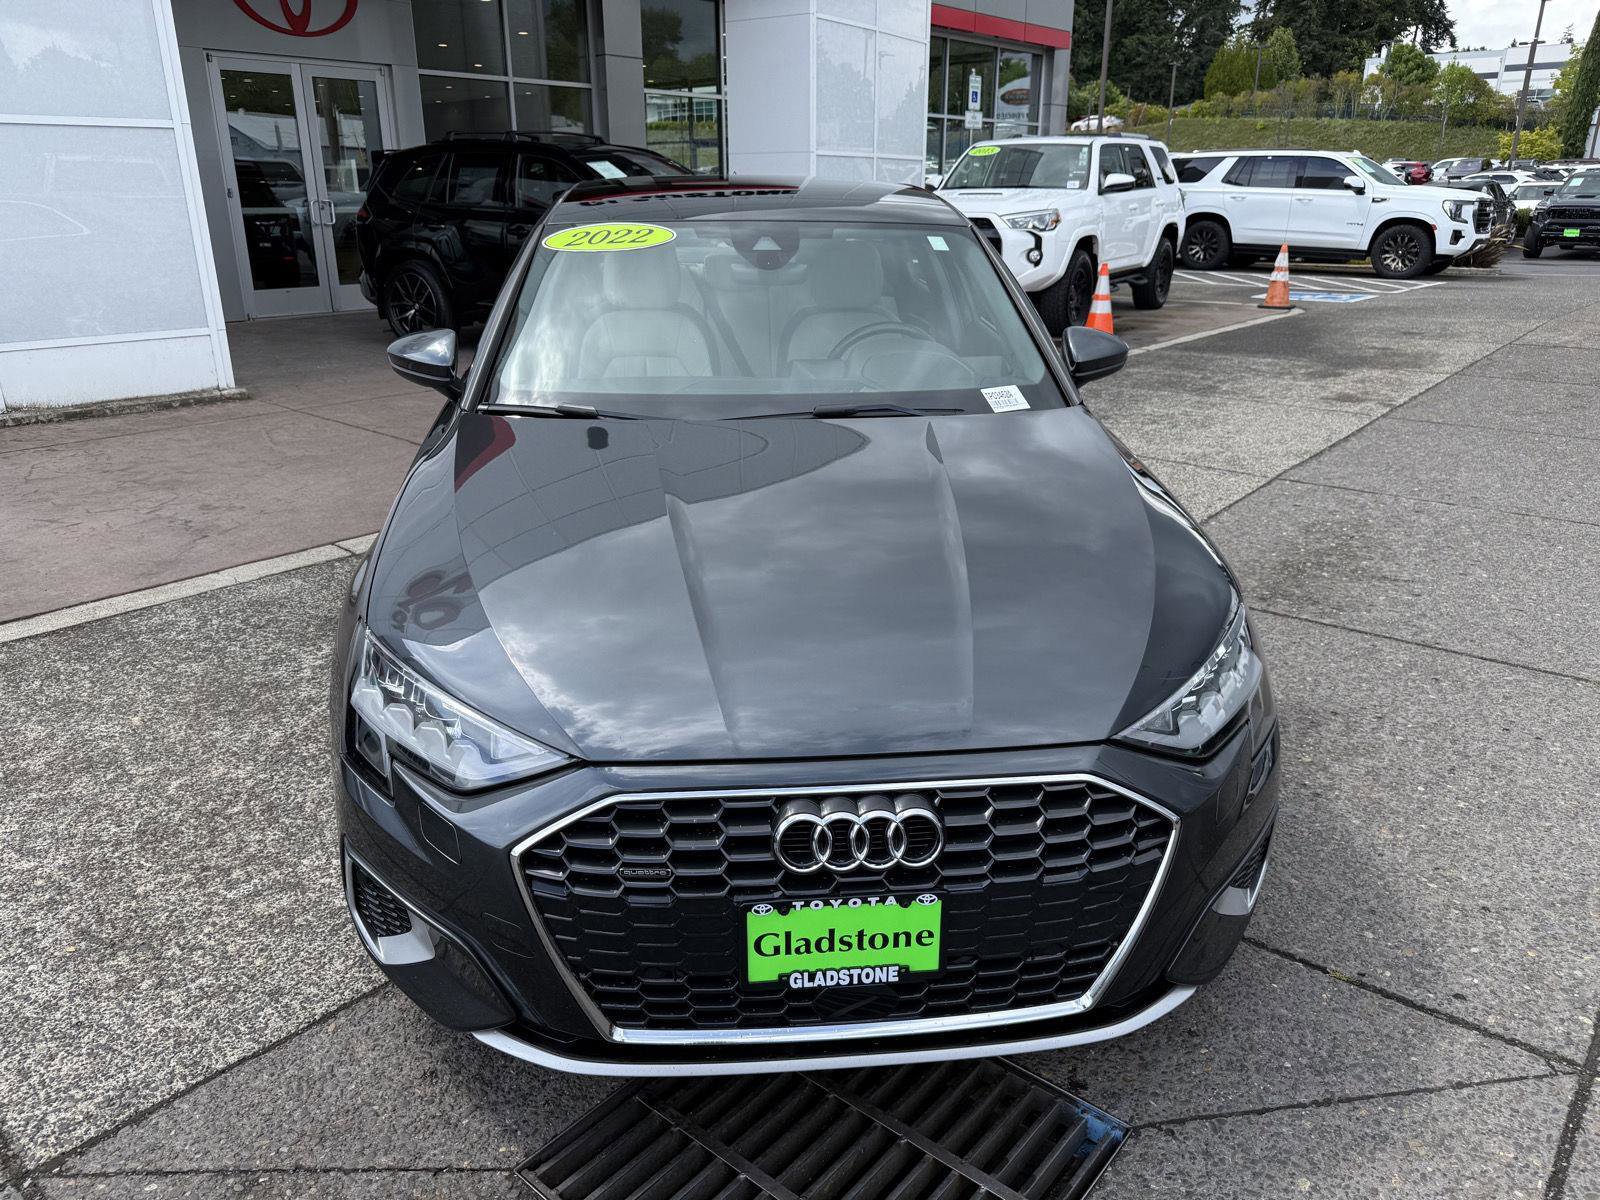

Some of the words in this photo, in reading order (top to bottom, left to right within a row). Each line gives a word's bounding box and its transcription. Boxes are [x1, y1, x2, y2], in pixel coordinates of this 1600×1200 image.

[563, 228, 654, 248] 2022
[792, 896, 897, 911] TOYOTA
[753, 928, 935, 957] Gladstone
[789, 966, 899, 988] GLADSTONE
